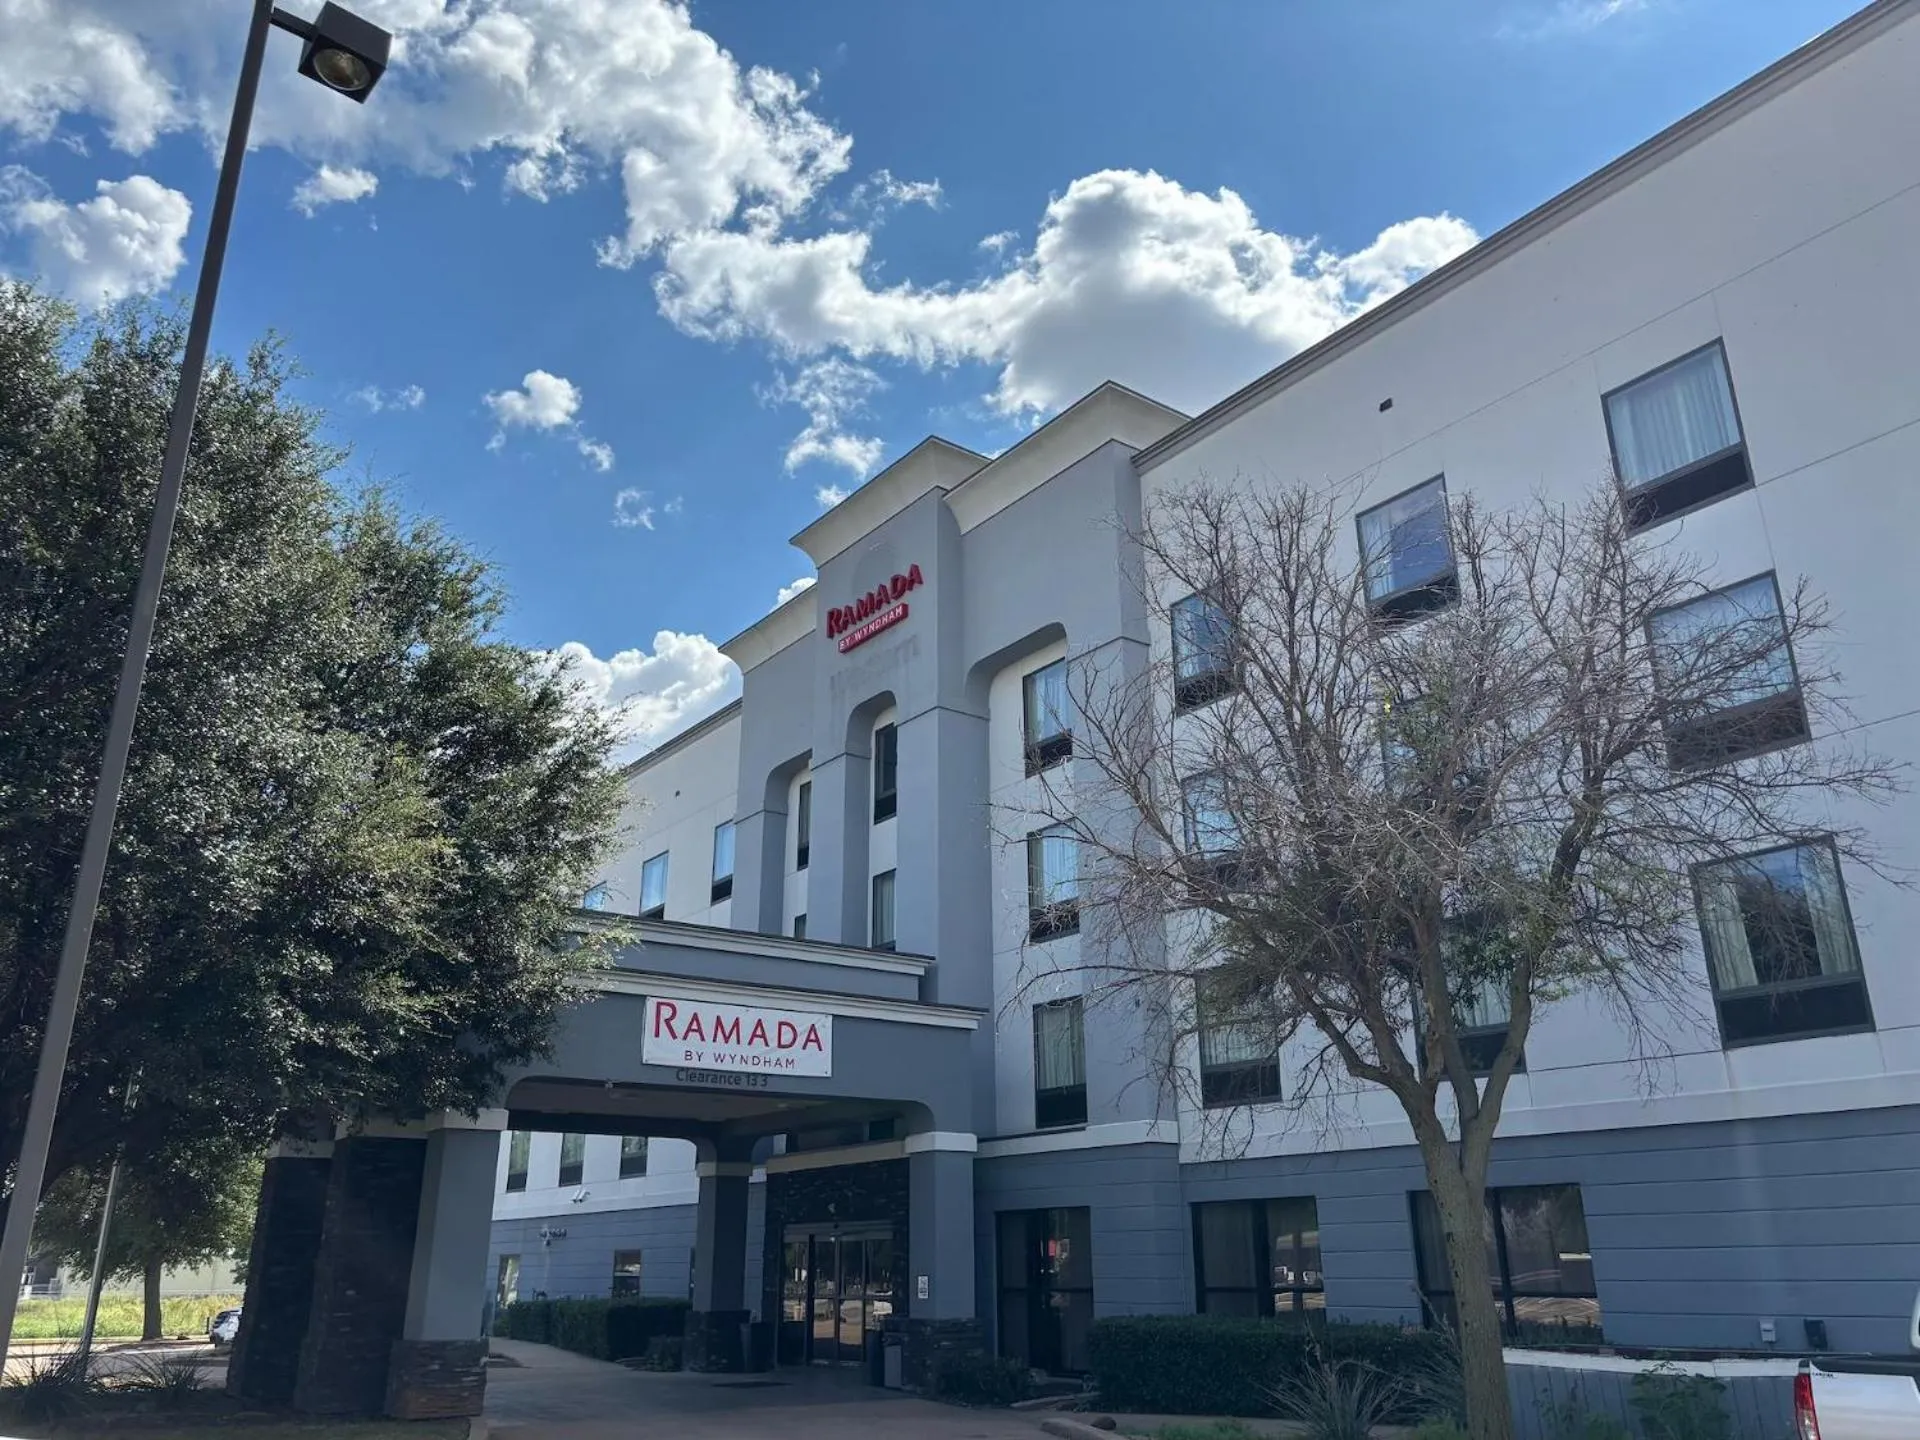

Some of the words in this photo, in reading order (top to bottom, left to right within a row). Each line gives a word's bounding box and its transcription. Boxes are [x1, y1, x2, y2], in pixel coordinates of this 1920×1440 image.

[826, 563, 923, 638] RAMADA
[854, 605, 903, 641] WYNDHAM
[654, 1001, 823, 1051] RAMADA
[676, 1067, 741, 1086] Clearance
[684, 1050, 704, 1062] BY
[713, 1053, 795, 1069] WYNDHAM
